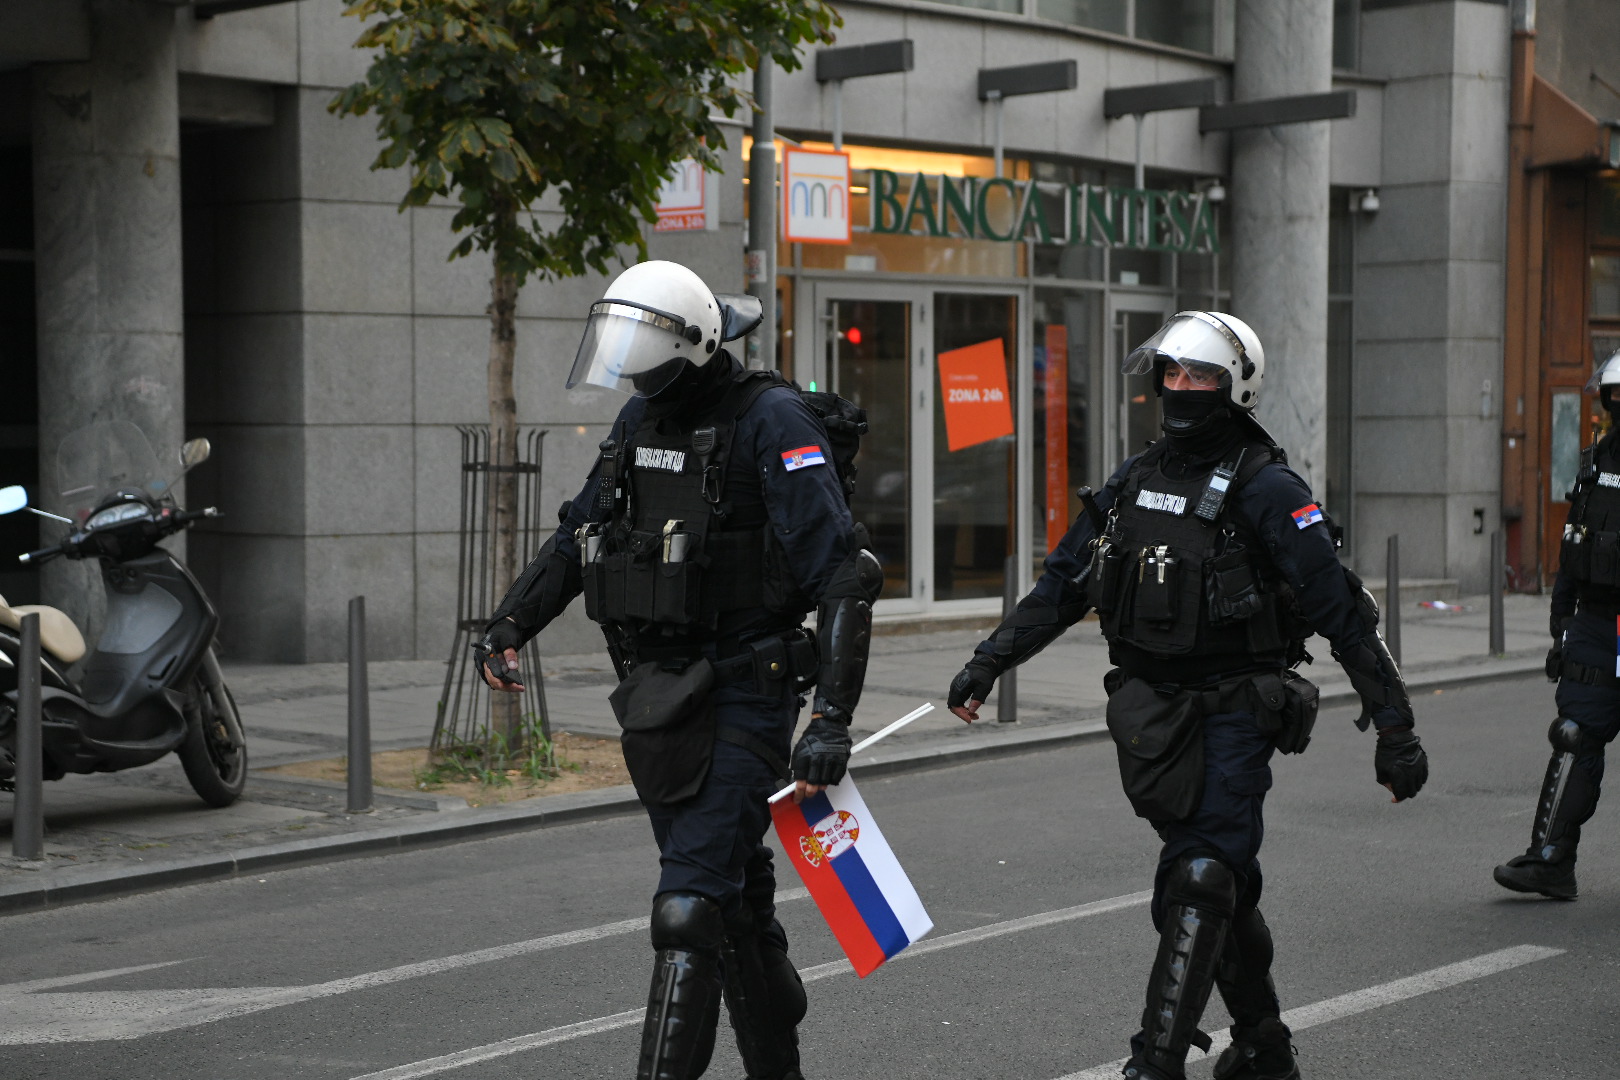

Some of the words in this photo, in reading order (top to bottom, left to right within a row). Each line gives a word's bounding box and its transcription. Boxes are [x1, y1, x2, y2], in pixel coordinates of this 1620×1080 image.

[870, 168, 1051, 244] BANCA
[1065, 183, 1220, 253] INTESA
[949, 388, 980, 403] ZONA
[983, 387, 1004, 402] 24h
